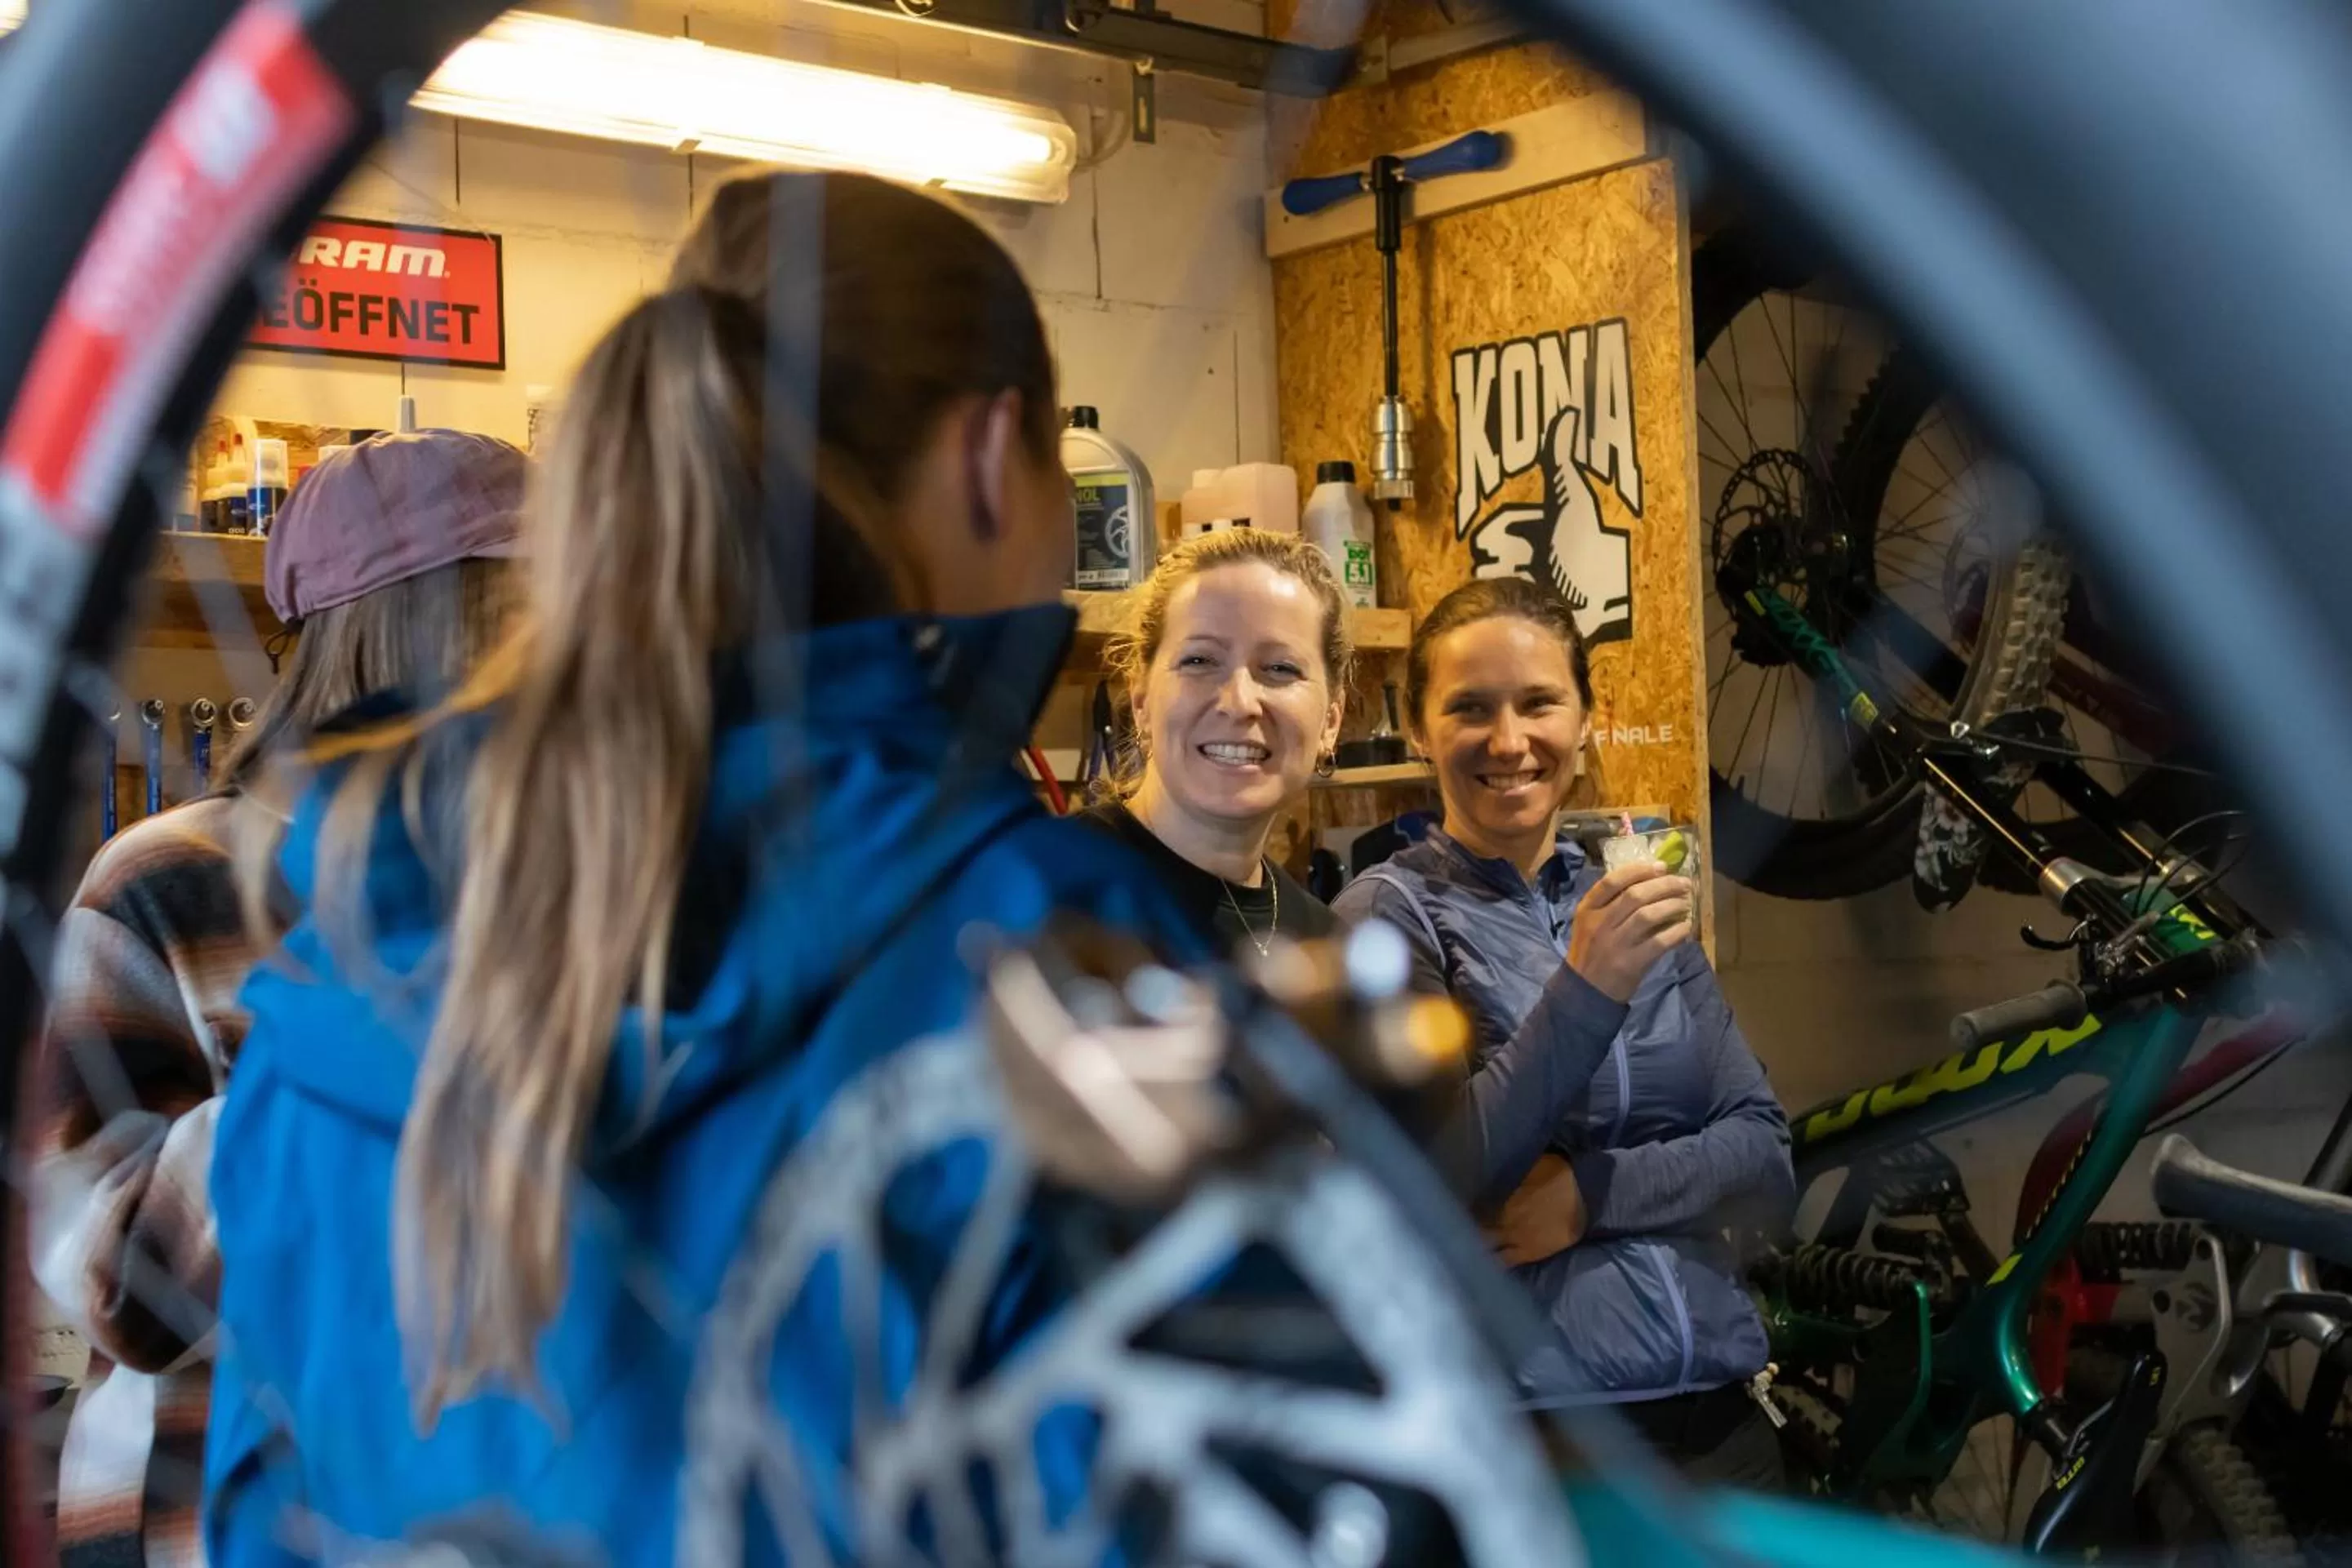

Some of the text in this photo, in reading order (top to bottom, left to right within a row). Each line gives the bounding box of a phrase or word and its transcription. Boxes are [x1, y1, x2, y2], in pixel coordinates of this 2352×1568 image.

[297, 236, 447, 278] RAM
[267, 278, 480, 344] EÖFFNET
[1452, 317, 1643, 540] KONA
